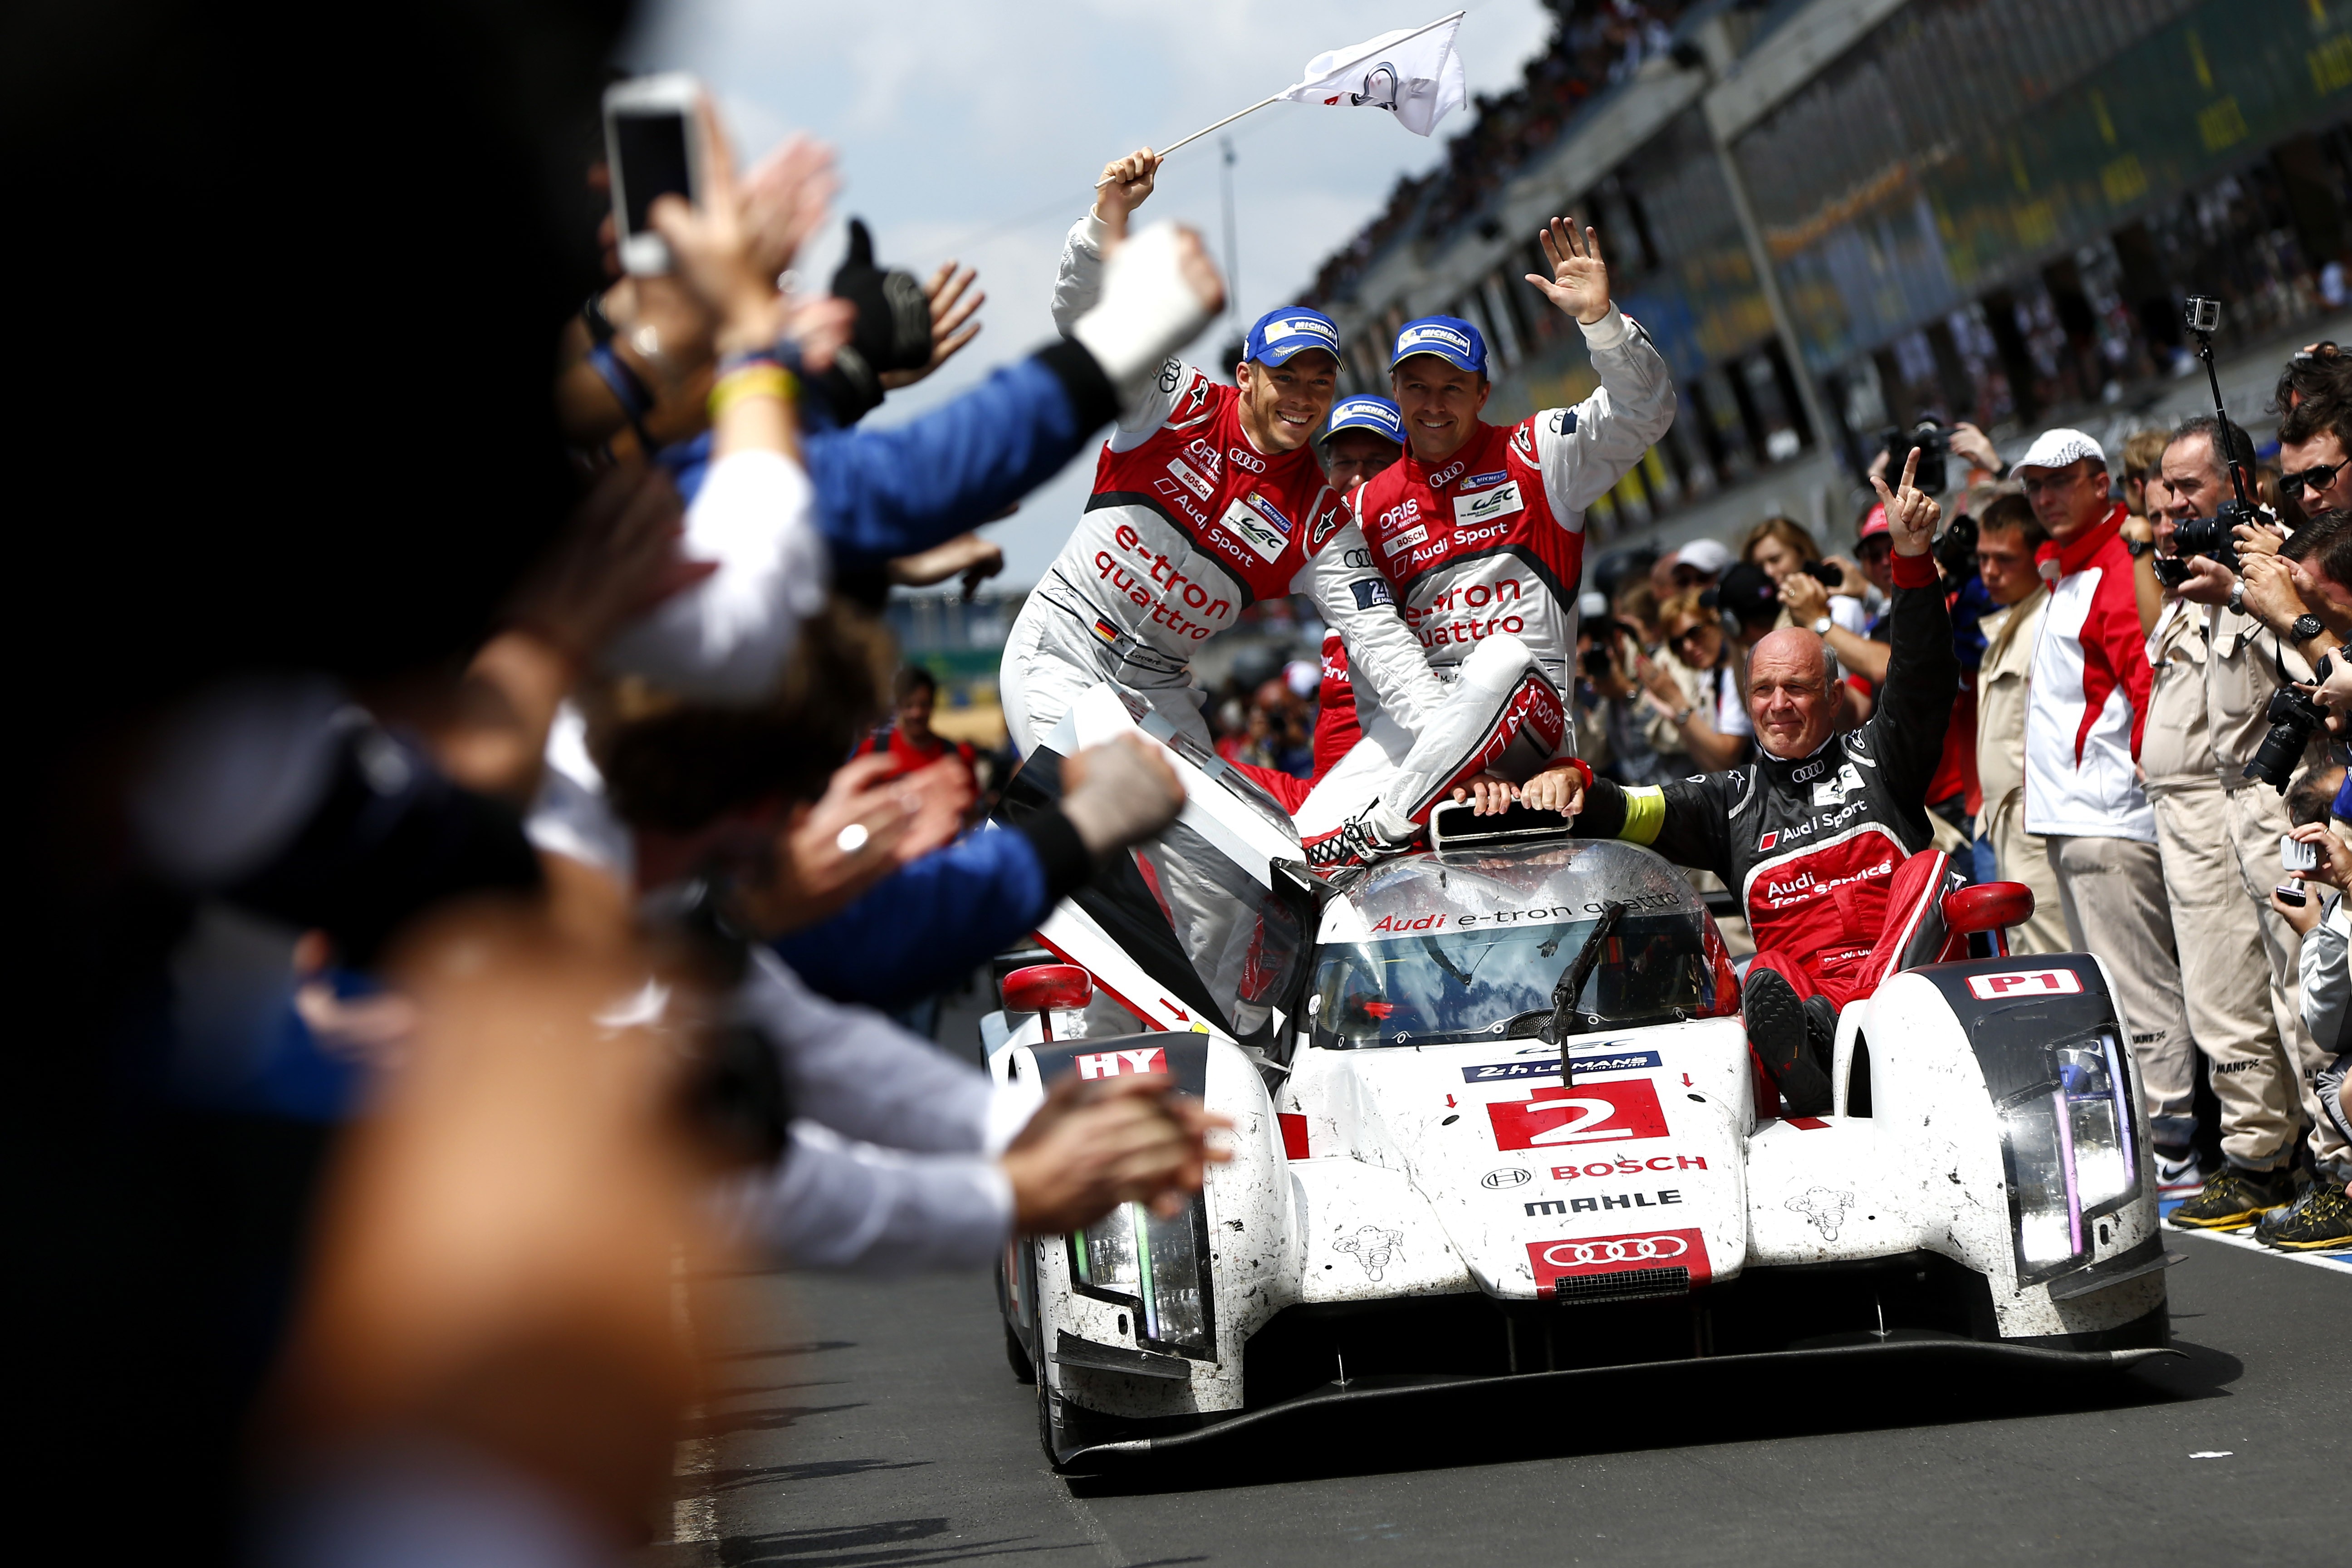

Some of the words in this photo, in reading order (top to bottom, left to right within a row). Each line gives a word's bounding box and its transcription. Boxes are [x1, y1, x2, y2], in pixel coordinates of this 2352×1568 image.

[1420, 329, 1467, 348] MICHELIN
[1352, 405, 1397, 423] MICHELIN
[1183, 472, 1210, 497] BOSCH
[1471, 487, 1515, 510] WEC
[1263, 505, 1290, 529] MICHELIN
[1379, 498, 1418, 529] ORIS
[1173, 494, 1208, 530] Audi
[1208, 528, 1254, 568] Sport
[1241, 518, 1283, 549] WEC
[1396, 529, 1425, 548] BOSCH
[1411, 538, 1448, 565] Audi
[1453, 522, 1508, 545] Sport
[1115, 524, 1230, 620] e-tron
[1095, 551, 1210, 640] quattro
[1406, 578, 1521, 627] e-tron
[1417, 615, 1524, 648] uattro
[1782, 816, 1818, 843] Audi
[1822, 800, 1867, 828] Sport
[1768, 871, 1816, 898] Audi
[1813, 862, 1892, 895] Service
[1370, 914, 1447, 932] Audi
[1458, 906, 1573, 926] e-tron
[1583, 892, 1680, 913] qattro
[1988, 974, 2060, 993] P1
[1078, 1049, 1160, 1080] HY
[1534, 1064, 1562, 1073] LE
[1571, 1057, 1648, 1069] MANS
[1525, 1098, 1632, 1145] 2
[1551, 1156, 1708, 1180] BOSCH
[1524, 1190, 1682, 1216] MAHLE
